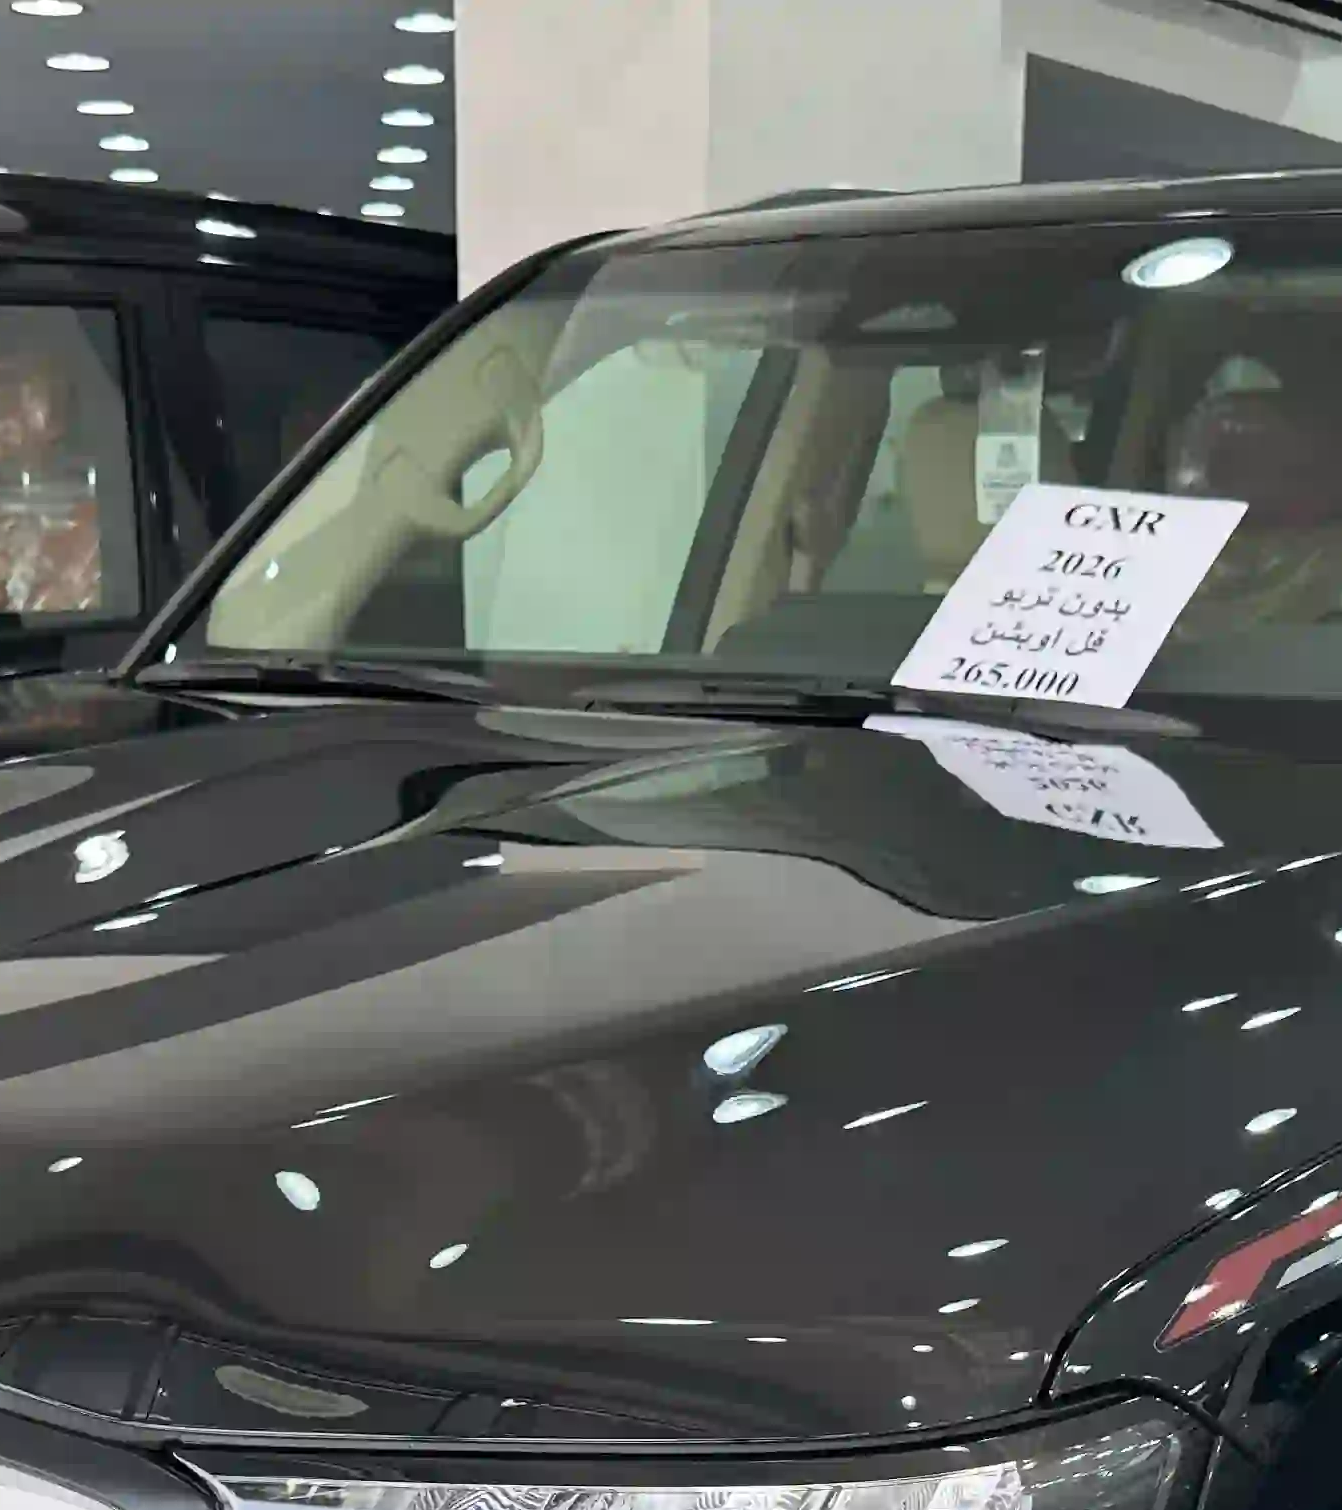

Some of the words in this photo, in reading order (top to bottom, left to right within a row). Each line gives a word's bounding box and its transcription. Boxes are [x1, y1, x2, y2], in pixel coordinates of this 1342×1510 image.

[1064, 503, 1166, 535] GXR
[1039, 550, 1130, 580] 2026
[990, 587, 1058, 610] تربو
[1059, 593, 1131, 621] بدون
[941, 657, 1079, 695] 265.000
